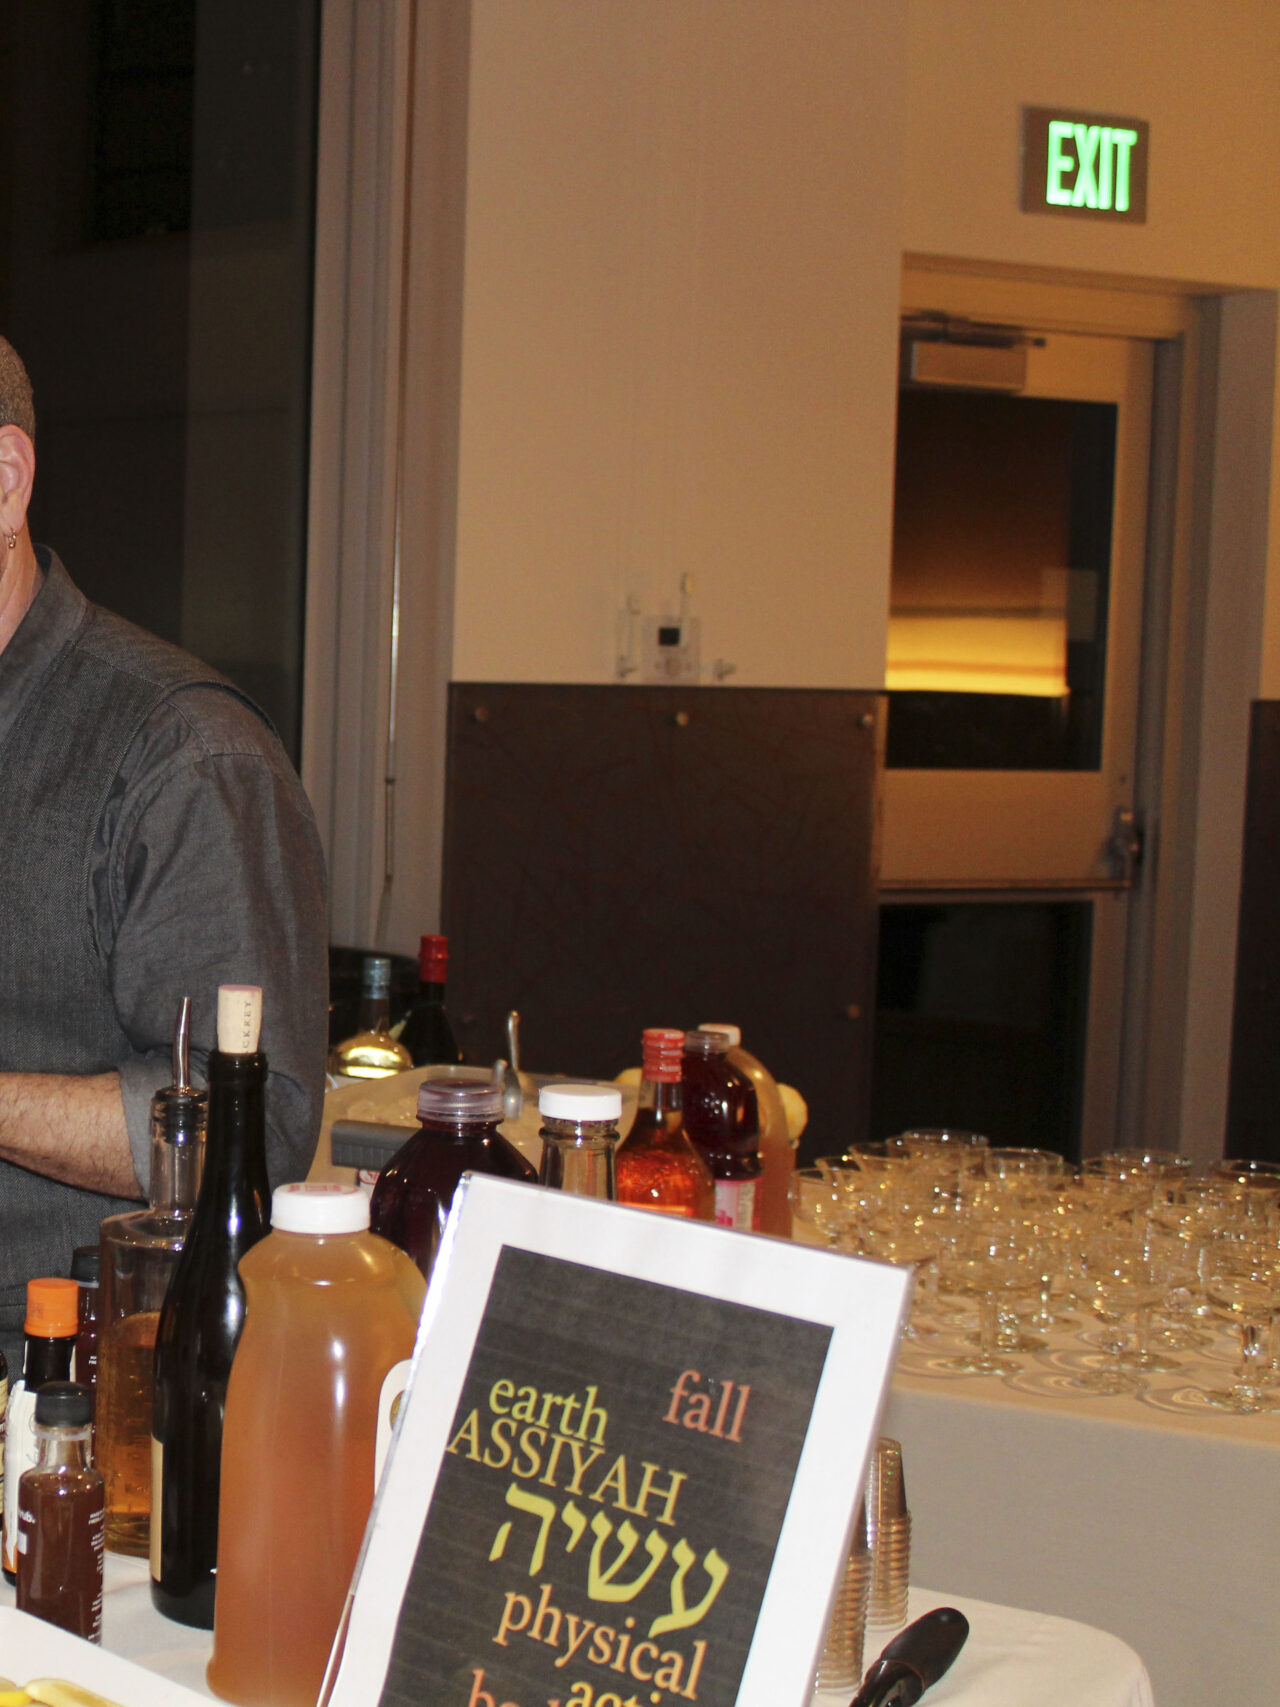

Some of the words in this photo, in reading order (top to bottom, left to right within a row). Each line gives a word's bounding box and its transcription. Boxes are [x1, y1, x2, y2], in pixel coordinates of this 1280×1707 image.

[1046, 120, 1138, 212] EXIT
[489, 1379, 608, 1446] earth
[663, 1369, 751, 1443] fall
[446, 1408, 687, 1526] ASSIYAH
[489, 1482, 729, 1638] עשיה
[492, 1584, 707, 1700] physical
